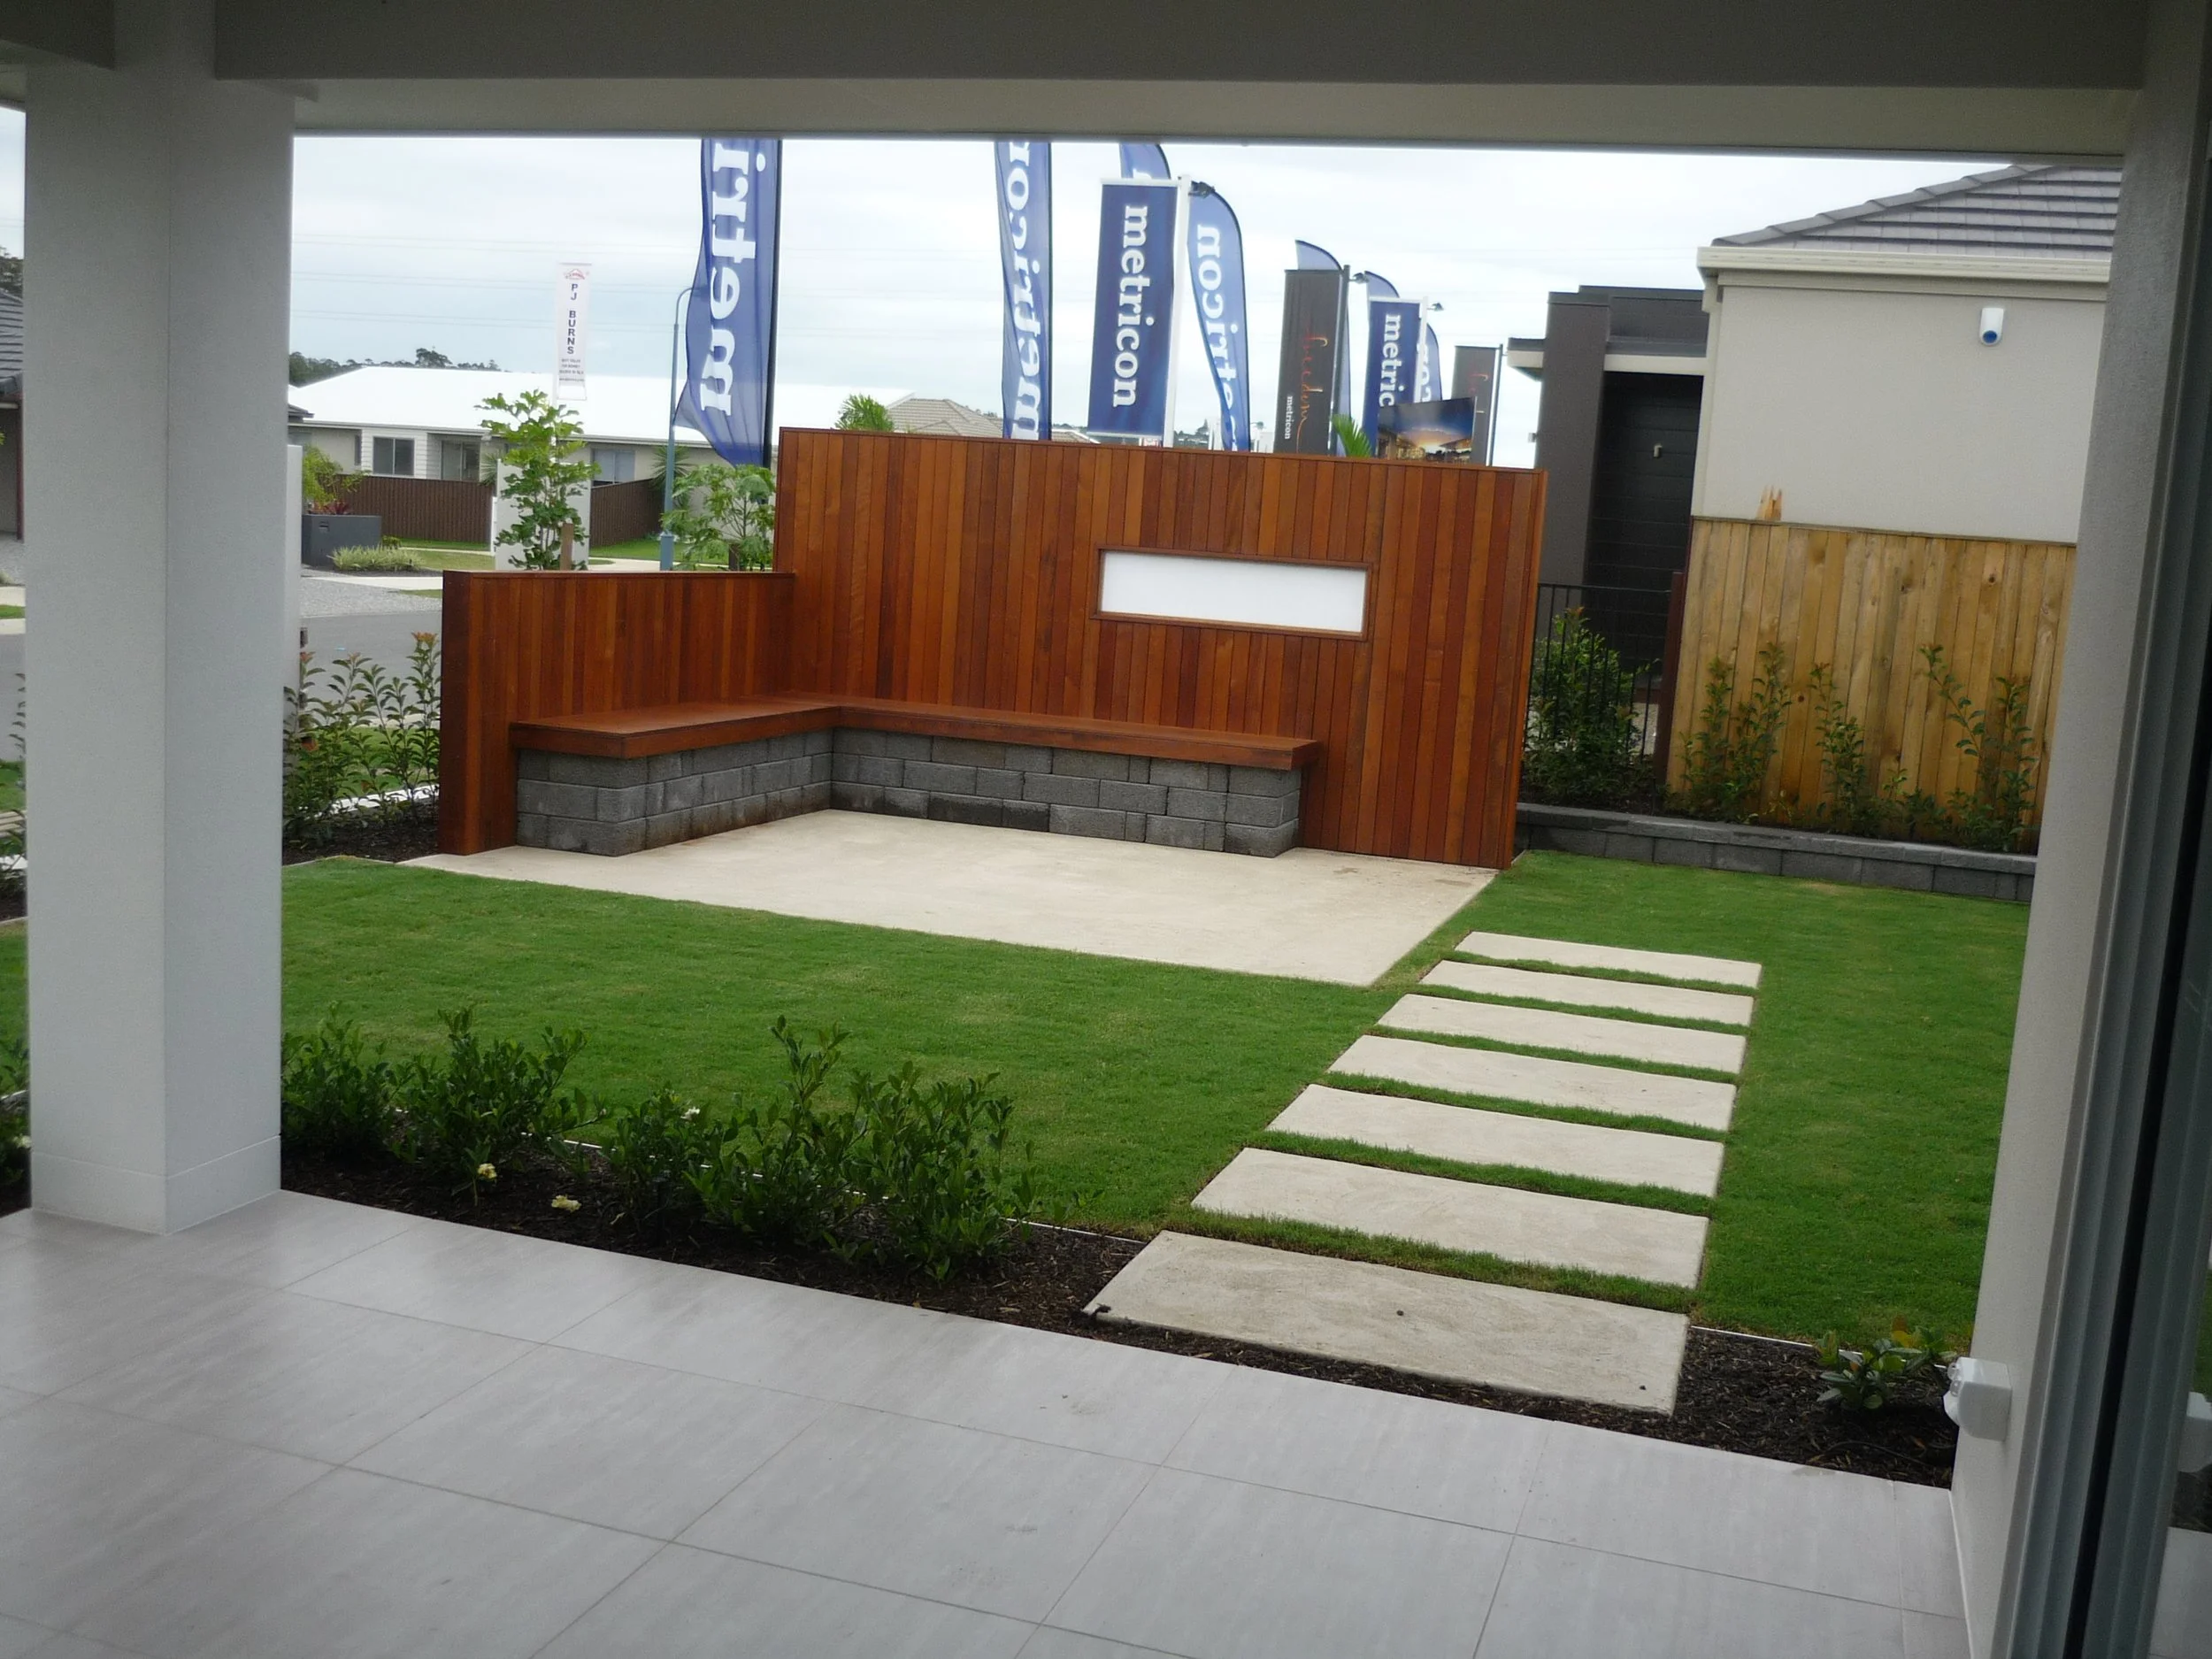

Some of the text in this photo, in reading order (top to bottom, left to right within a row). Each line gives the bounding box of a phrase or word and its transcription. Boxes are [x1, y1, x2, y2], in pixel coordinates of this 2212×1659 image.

[571, 283, 579, 301] PJ
[1112, 204, 1155, 408] metricon
[567, 310, 576, 355] BURNS
[1284, 396, 1294, 440] metricon
